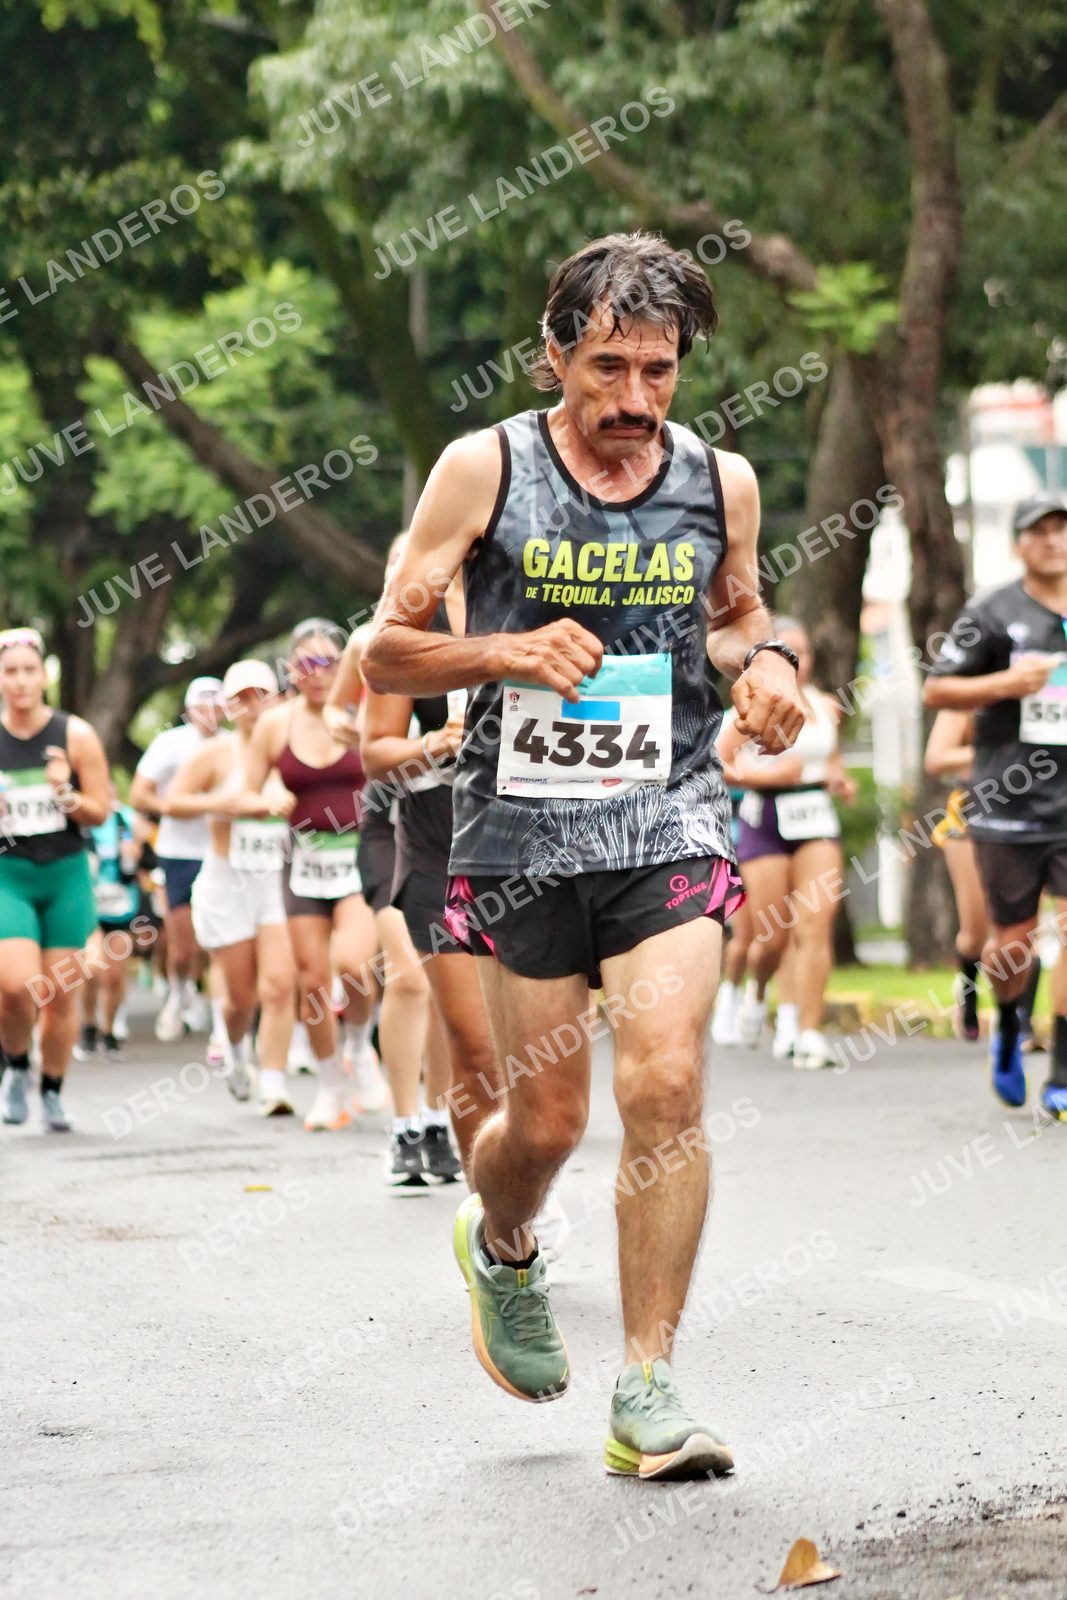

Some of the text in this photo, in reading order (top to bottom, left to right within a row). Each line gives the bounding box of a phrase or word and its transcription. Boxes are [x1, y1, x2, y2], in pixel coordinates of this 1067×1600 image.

[523, 538, 695, 582] GACELAS
[526, 583, 695, 607] DE TEQUILA, JALISCO
[1027, 702, 1067, 722] 55
[513, 717, 660, 769] 4334
[664, 882, 707, 910] TOPTIME
